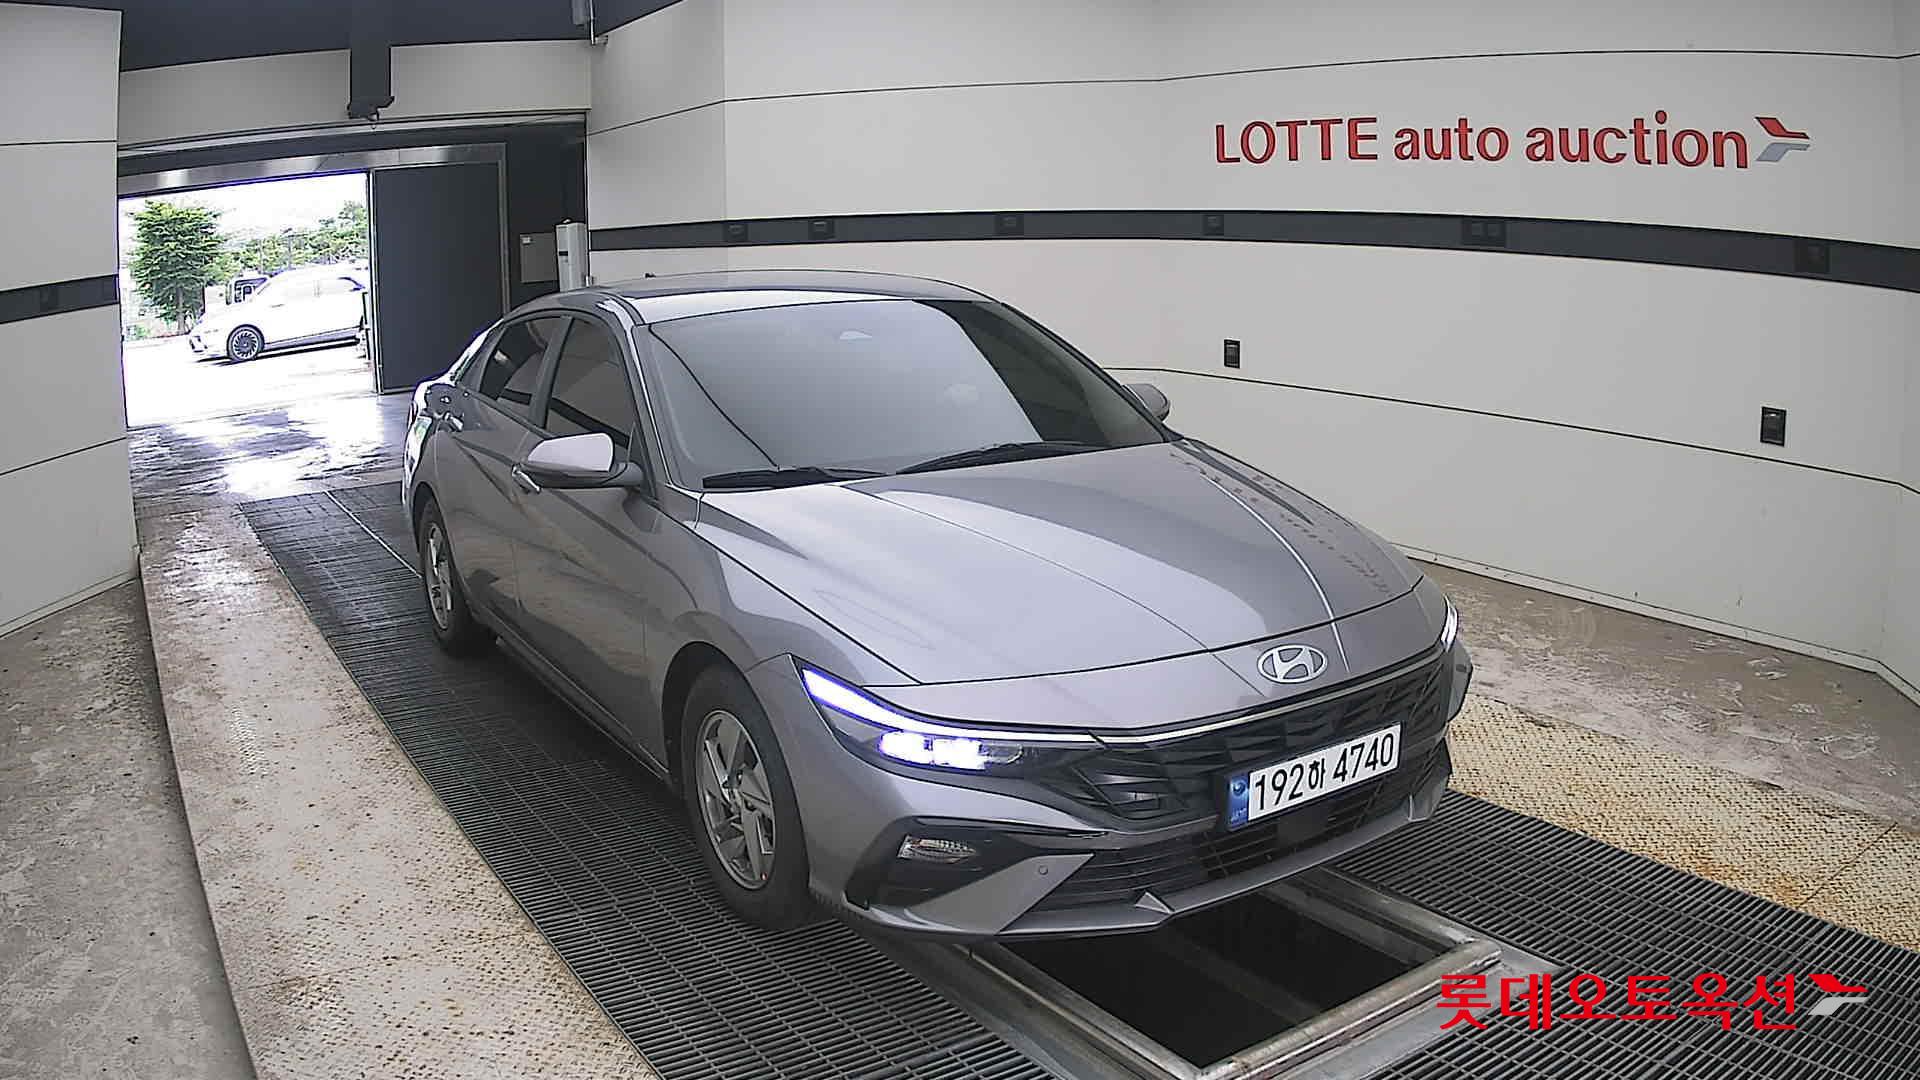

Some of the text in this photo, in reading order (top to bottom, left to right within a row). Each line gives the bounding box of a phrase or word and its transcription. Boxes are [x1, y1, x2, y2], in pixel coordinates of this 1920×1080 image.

[1215, 110, 1749, 169] LOTTE auto auction
[1255, 733, 1394, 810] 192하 4740
